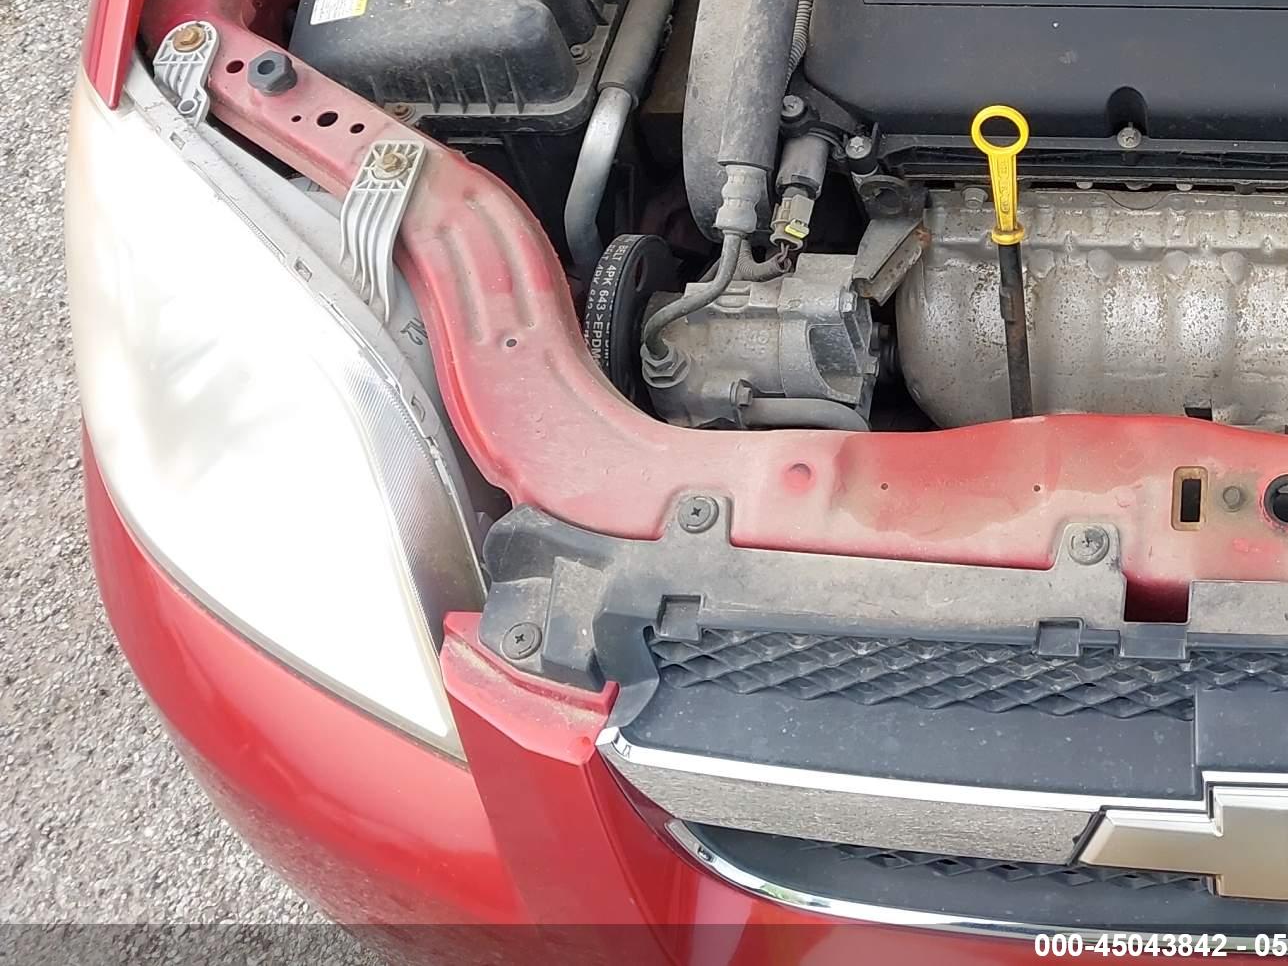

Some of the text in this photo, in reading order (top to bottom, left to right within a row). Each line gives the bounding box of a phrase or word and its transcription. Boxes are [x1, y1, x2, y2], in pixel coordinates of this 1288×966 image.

[612, 244, 628, 262] BELT
[603, 264, 617, 286] 4PK
[596, 289, 610, 311] 643
